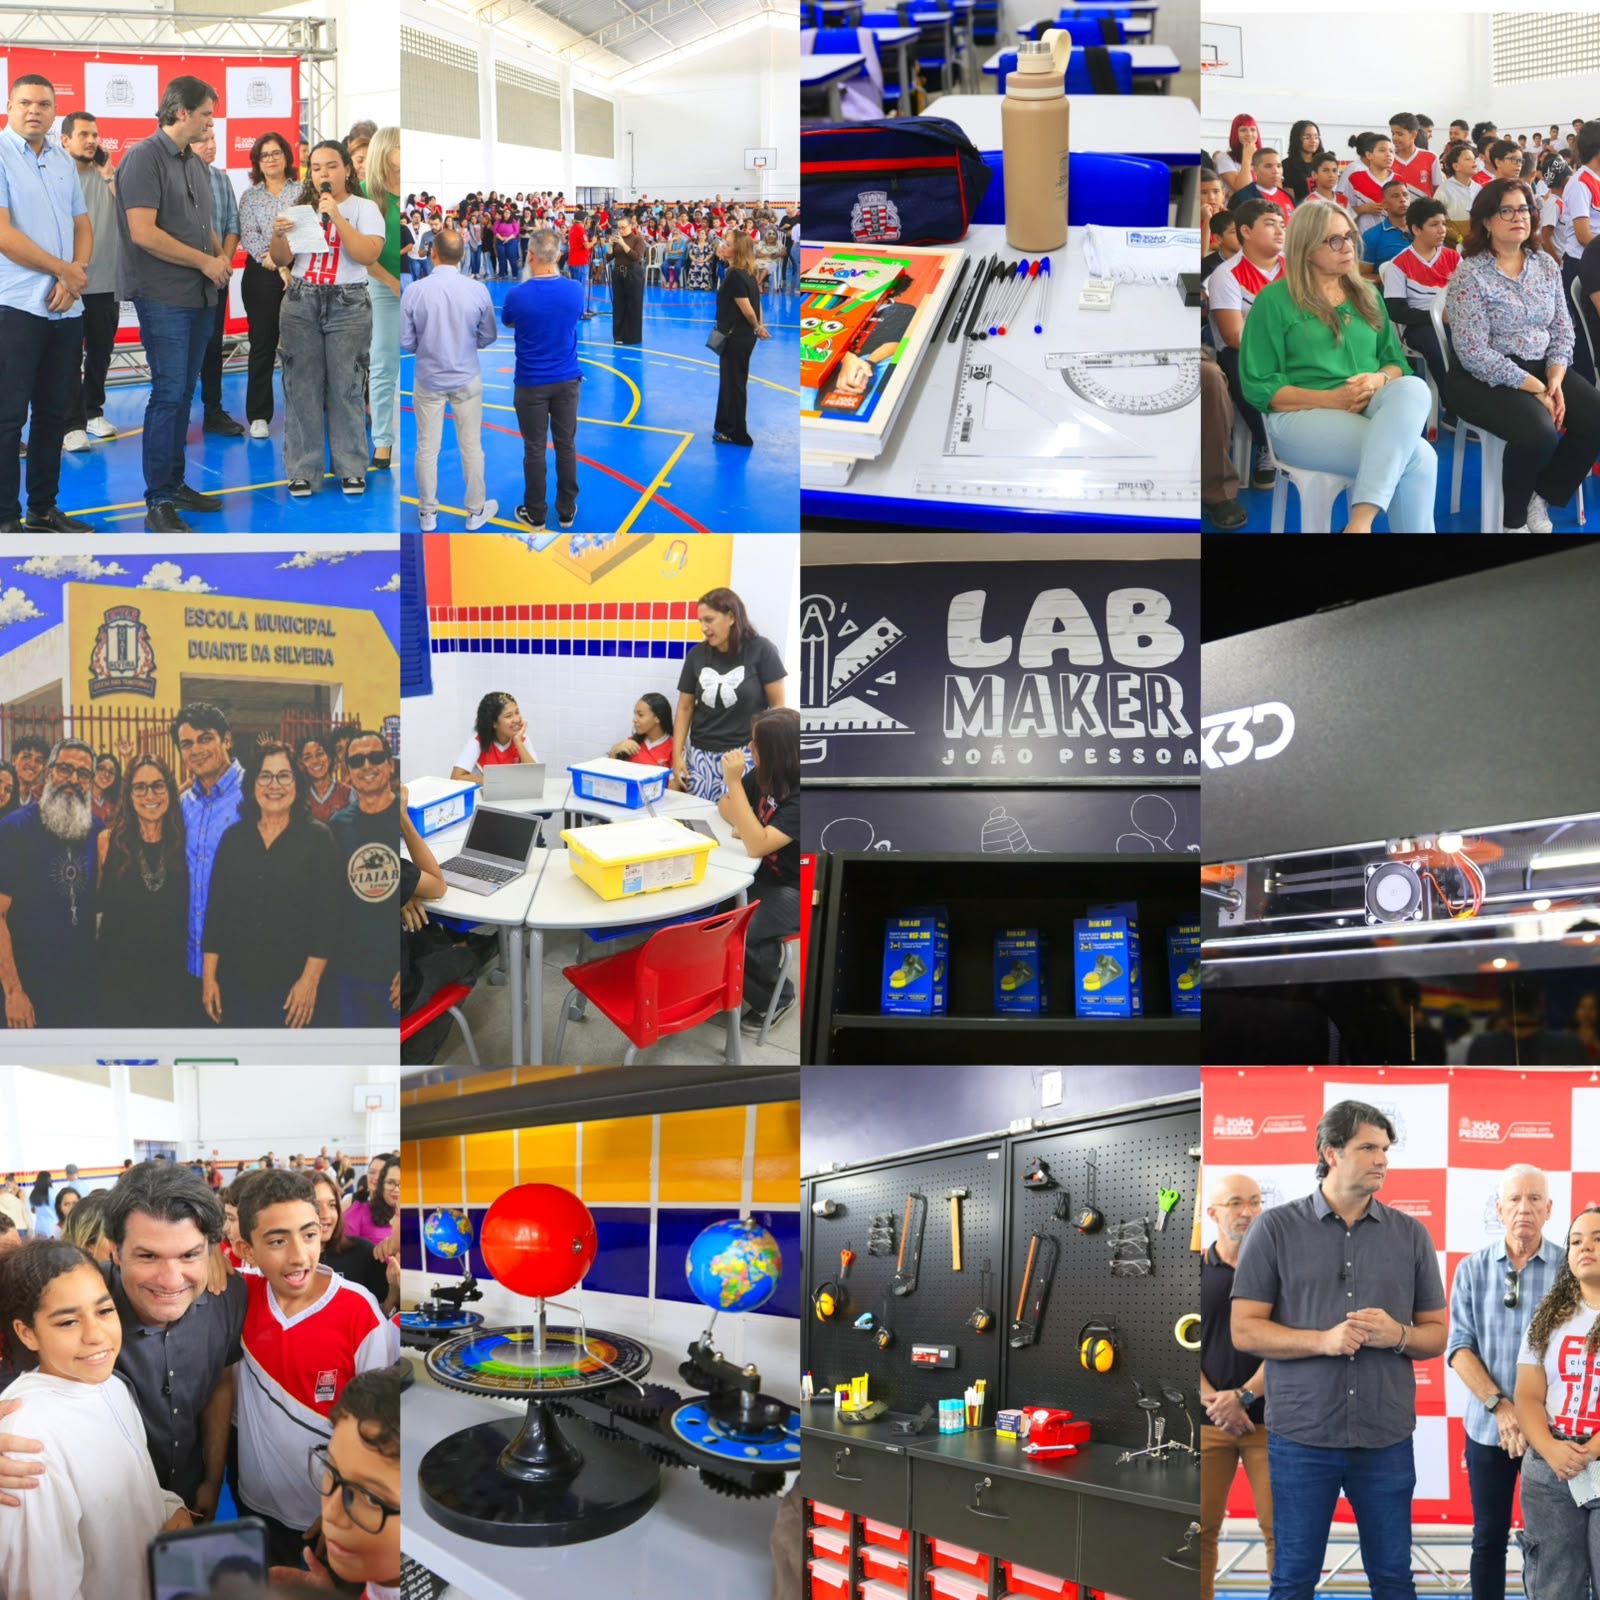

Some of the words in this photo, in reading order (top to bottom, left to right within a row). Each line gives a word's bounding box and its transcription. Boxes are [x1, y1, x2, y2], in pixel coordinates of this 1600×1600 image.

[184, 607, 249, 630] ESCOLA
[255, 613, 337, 637] MUNICIPAL
[947, 588, 1185, 668] LAB
[188, 640, 248, 662] DUARTE
[251, 644, 271, 663] DA
[274, 645, 335, 666] SILVEIRA
[943, 673, 1193, 738] MAKER
[942, 745, 1033, 765] JOÃO
[1059, 748, 1199, 765] PESSOA
[1458, 1129, 1500, 1140] PESSOA
[1471, 1120, 1501, 1131] JOÃO
